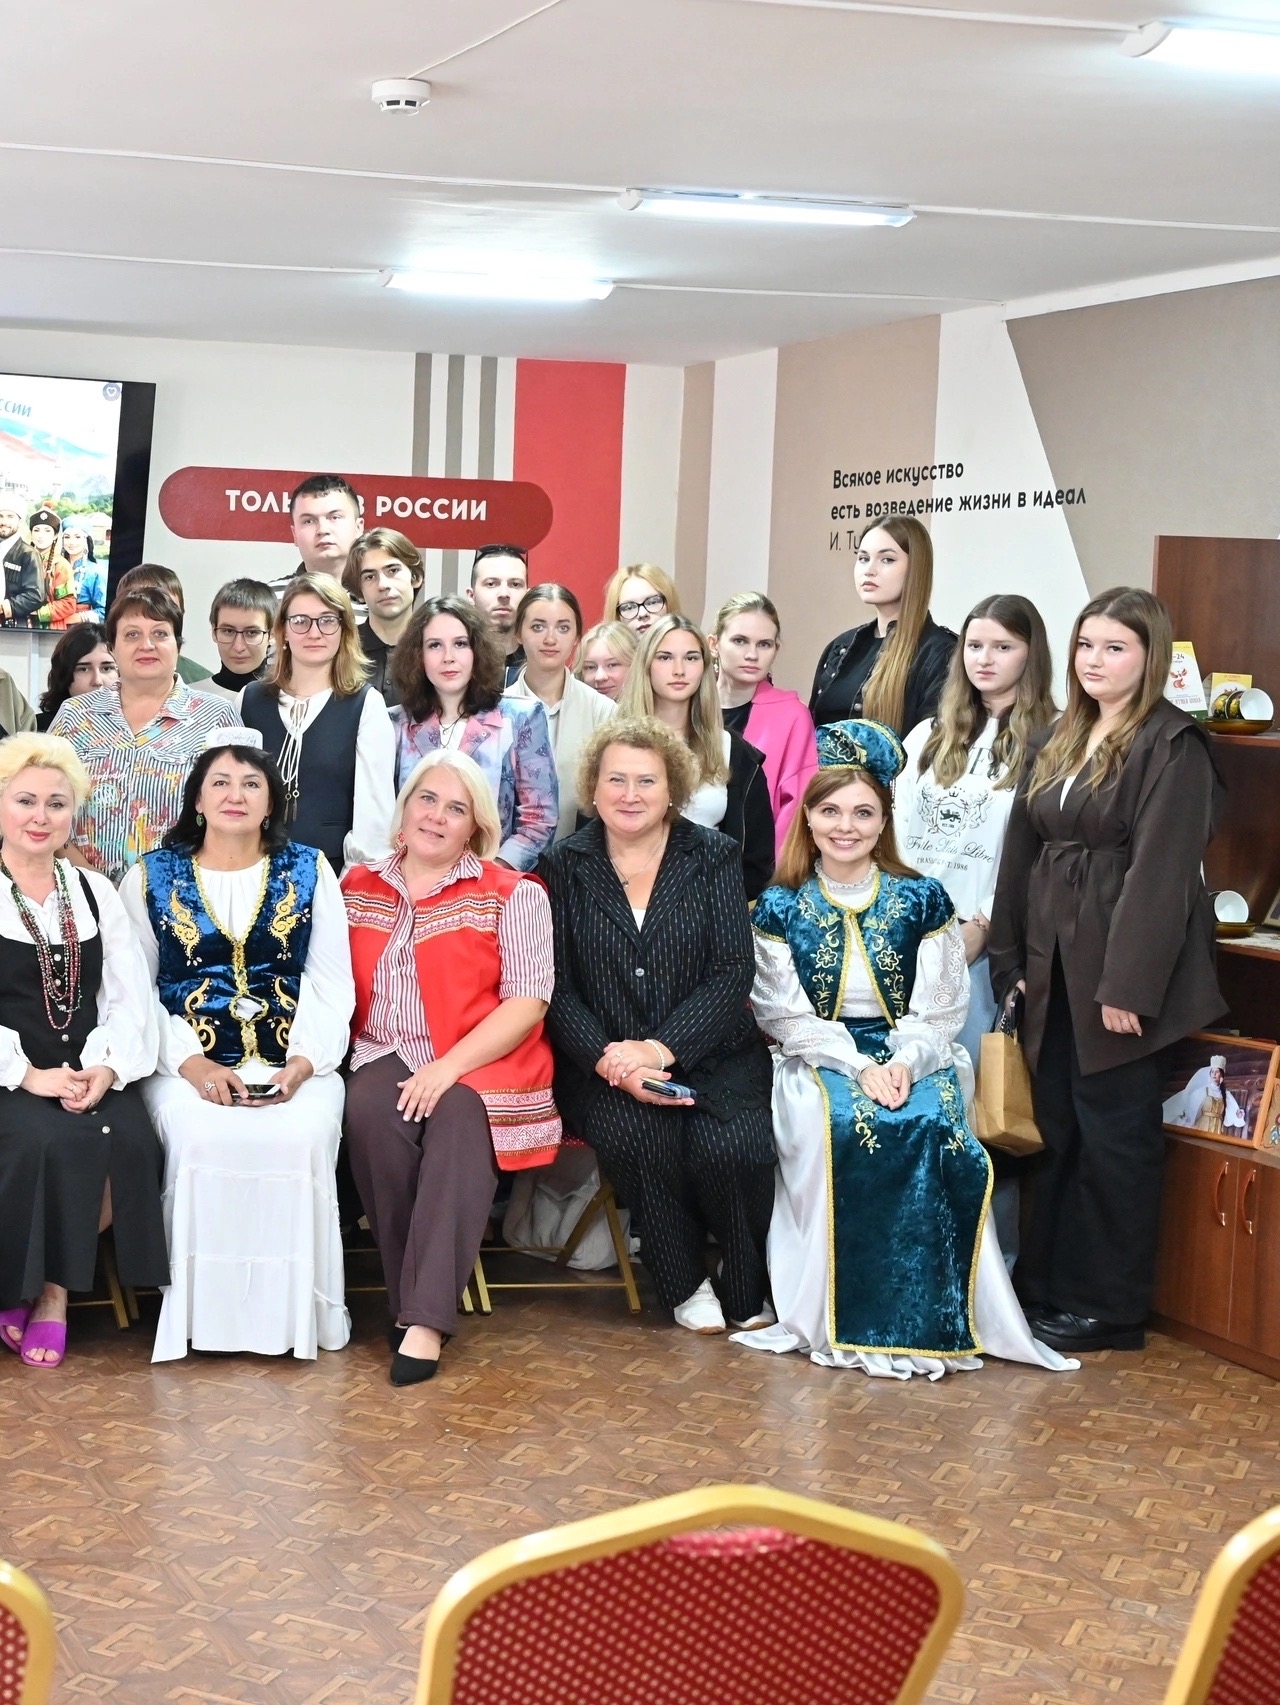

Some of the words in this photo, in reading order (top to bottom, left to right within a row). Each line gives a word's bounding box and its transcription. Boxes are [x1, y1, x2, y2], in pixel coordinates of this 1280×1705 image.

[832, 469, 882, 489] Всякое
[886, 462, 965, 487] искусство
[225, 489, 292, 513] ТОЛЬ
[376, 495, 488, 521] РОССИИ
[830, 503, 861, 520] есть
[865, 496, 954, 517] возведение
[958, 491, 1012, 512] жизни
[1017, 491, 1027, 508] в
[1032, 487, 1087, 509] идеал
[829, 531, 842, 551] И.
